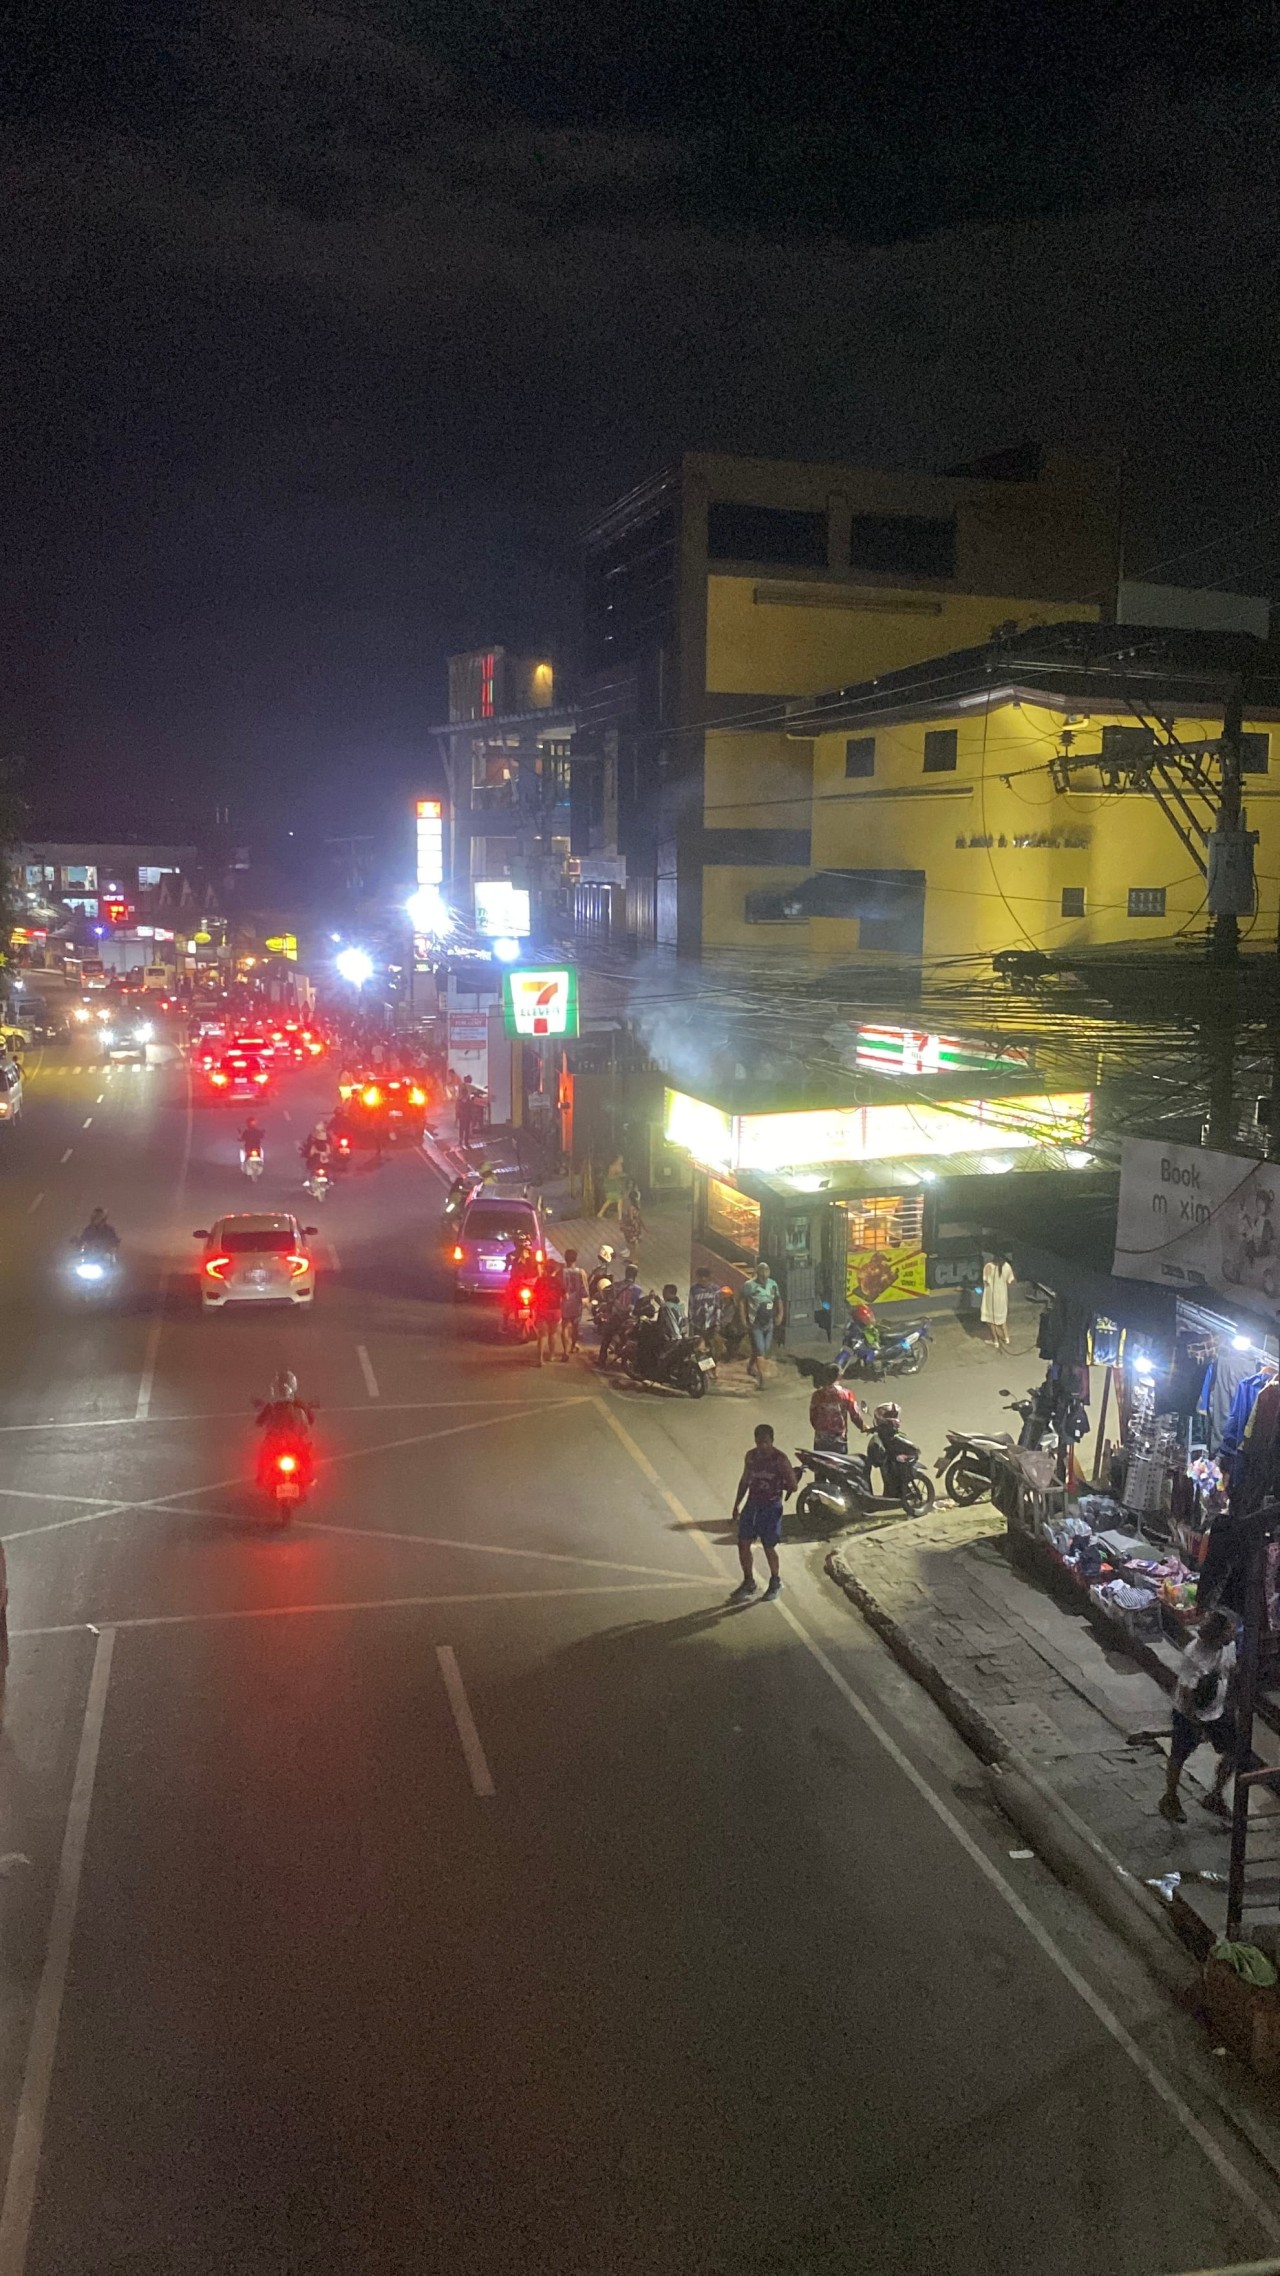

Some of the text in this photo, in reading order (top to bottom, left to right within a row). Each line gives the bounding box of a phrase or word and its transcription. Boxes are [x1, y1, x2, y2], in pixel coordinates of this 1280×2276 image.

[521, 981, 558, 1033] 7
[1161, 1158, 1200, 1189] Book
[1153, 1193, 1211, 1225] mxim
